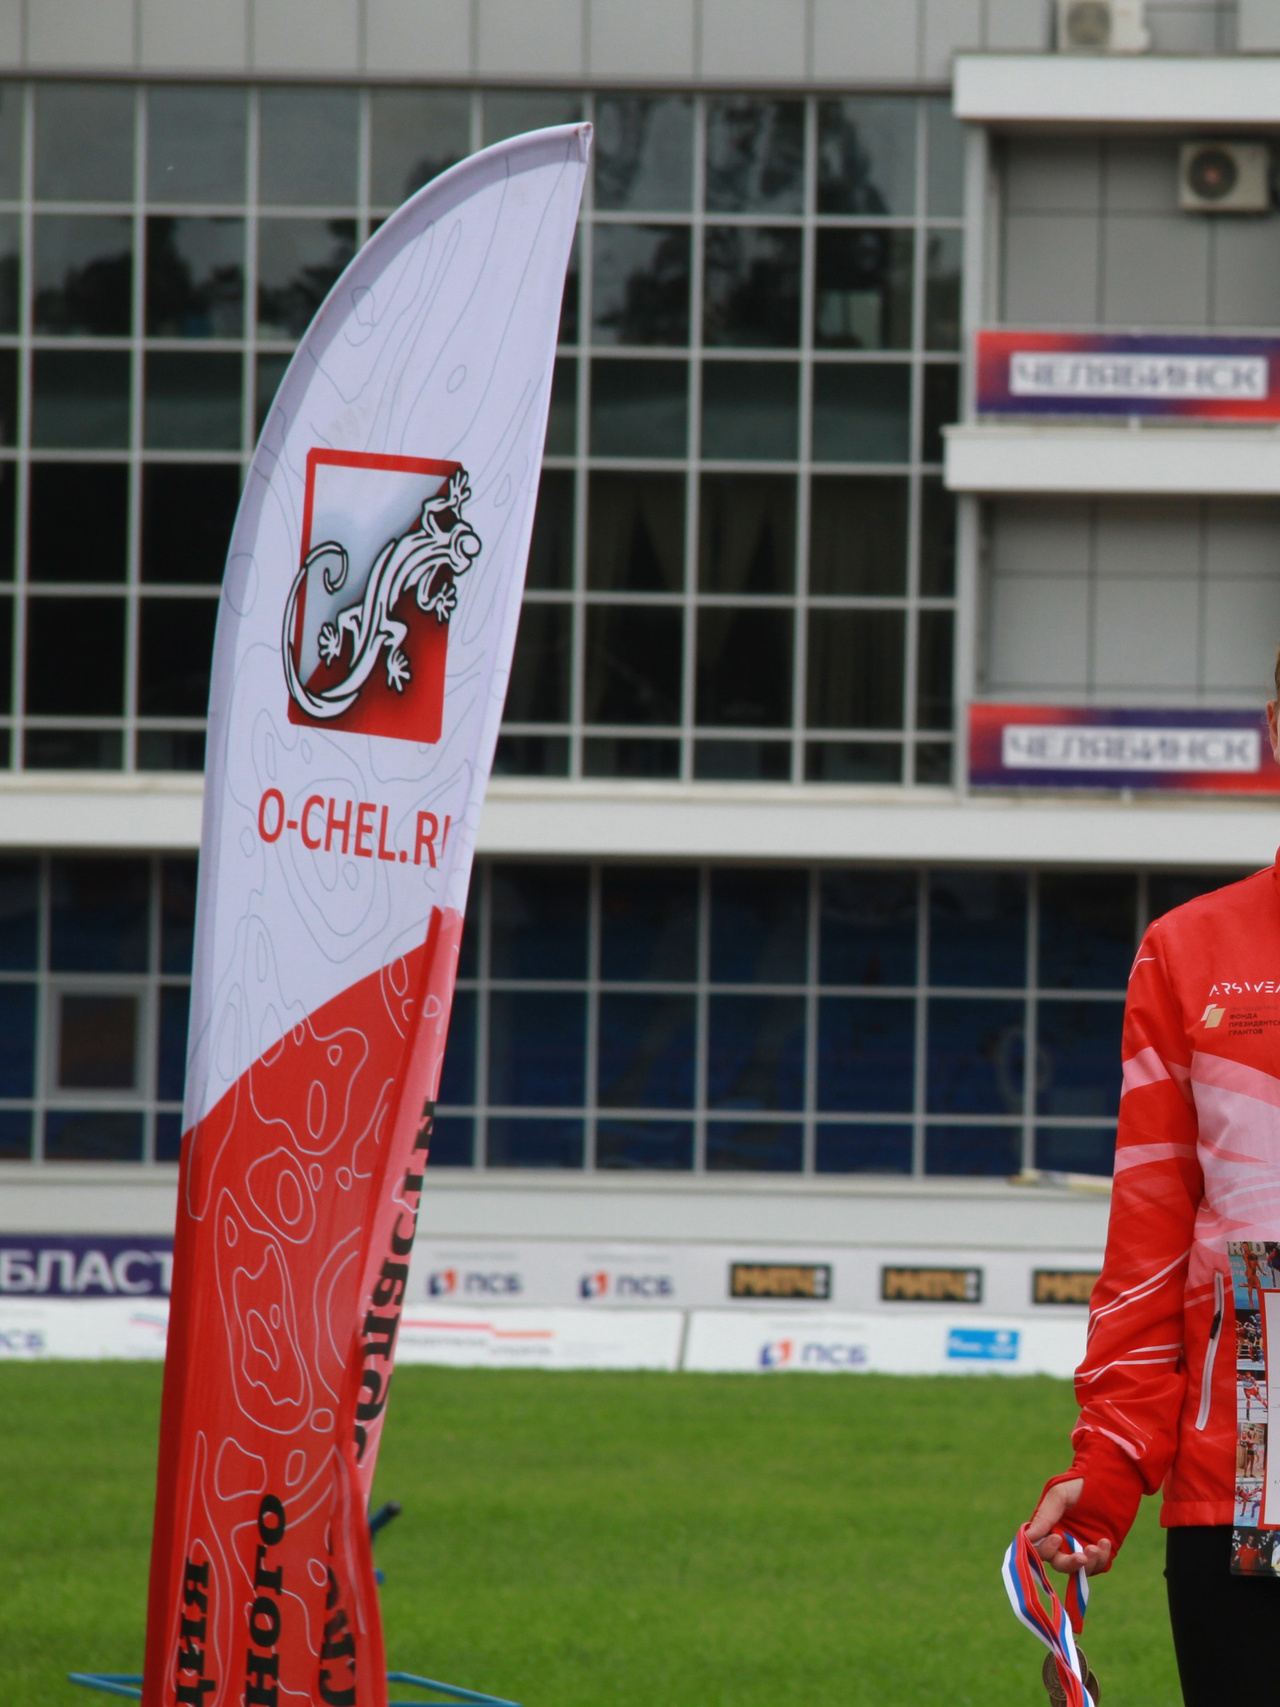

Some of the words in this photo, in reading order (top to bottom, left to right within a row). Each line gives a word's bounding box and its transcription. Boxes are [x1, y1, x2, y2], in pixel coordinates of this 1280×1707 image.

[1016, 357, 1259, 393] ЧЕЛЯБИНСК
[1010, 730, 1253, 768] ЧЕЛЯБИНСК
[1229, 1012, 1258, 1020] ФОНДА
[1228, 1028, 1263, 1036] ГРАНТОВ
